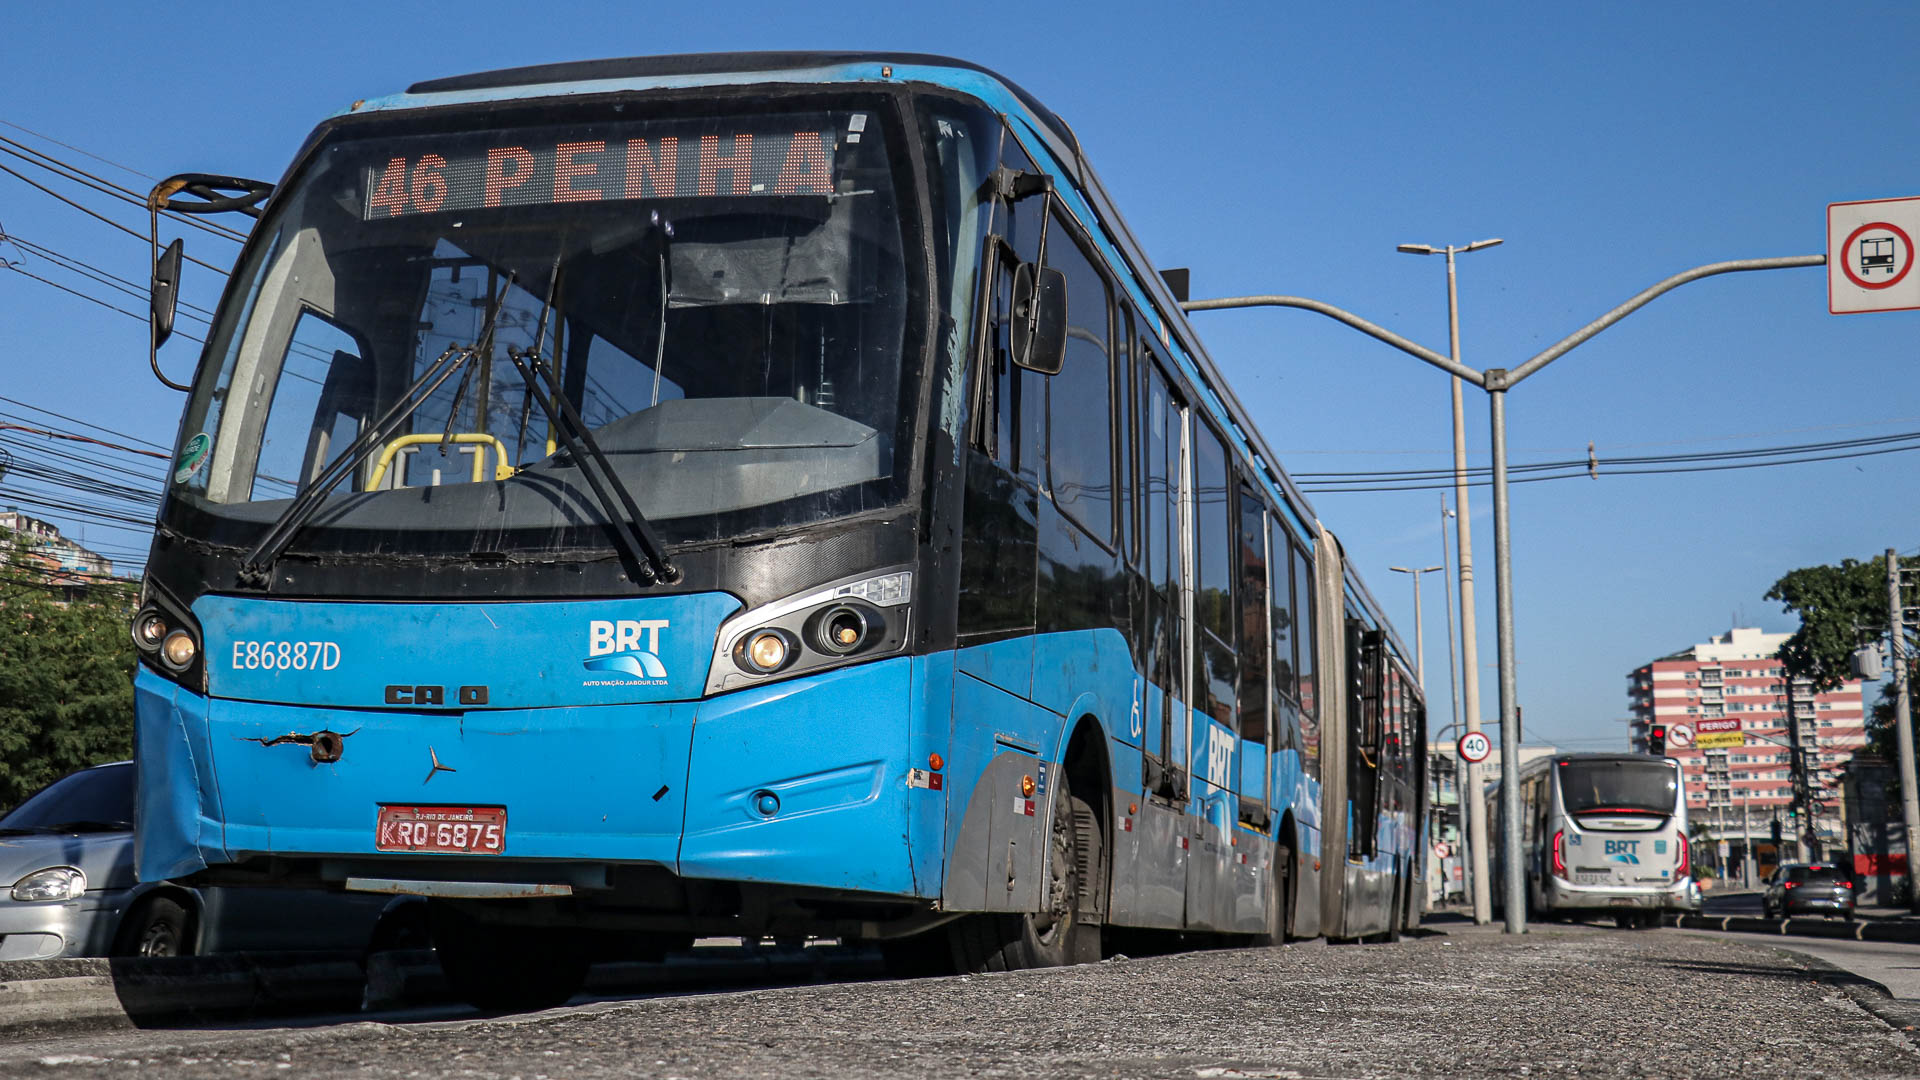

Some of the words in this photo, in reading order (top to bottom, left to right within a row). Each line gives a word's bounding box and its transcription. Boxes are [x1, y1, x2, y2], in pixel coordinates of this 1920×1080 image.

[370, 154, 448, 216] 46
[484, 132, 835, 208] PENHA
[589, 619, 670, 657] BRT
[232, 641, 341, 671] E86887D
[1699, 720, 1738, 732] PERIGO
[1466, 738, 1485, 752] 40
[1207, 724, 1235, 799] BRT
[1605, 839, 1641, 855] BRT
